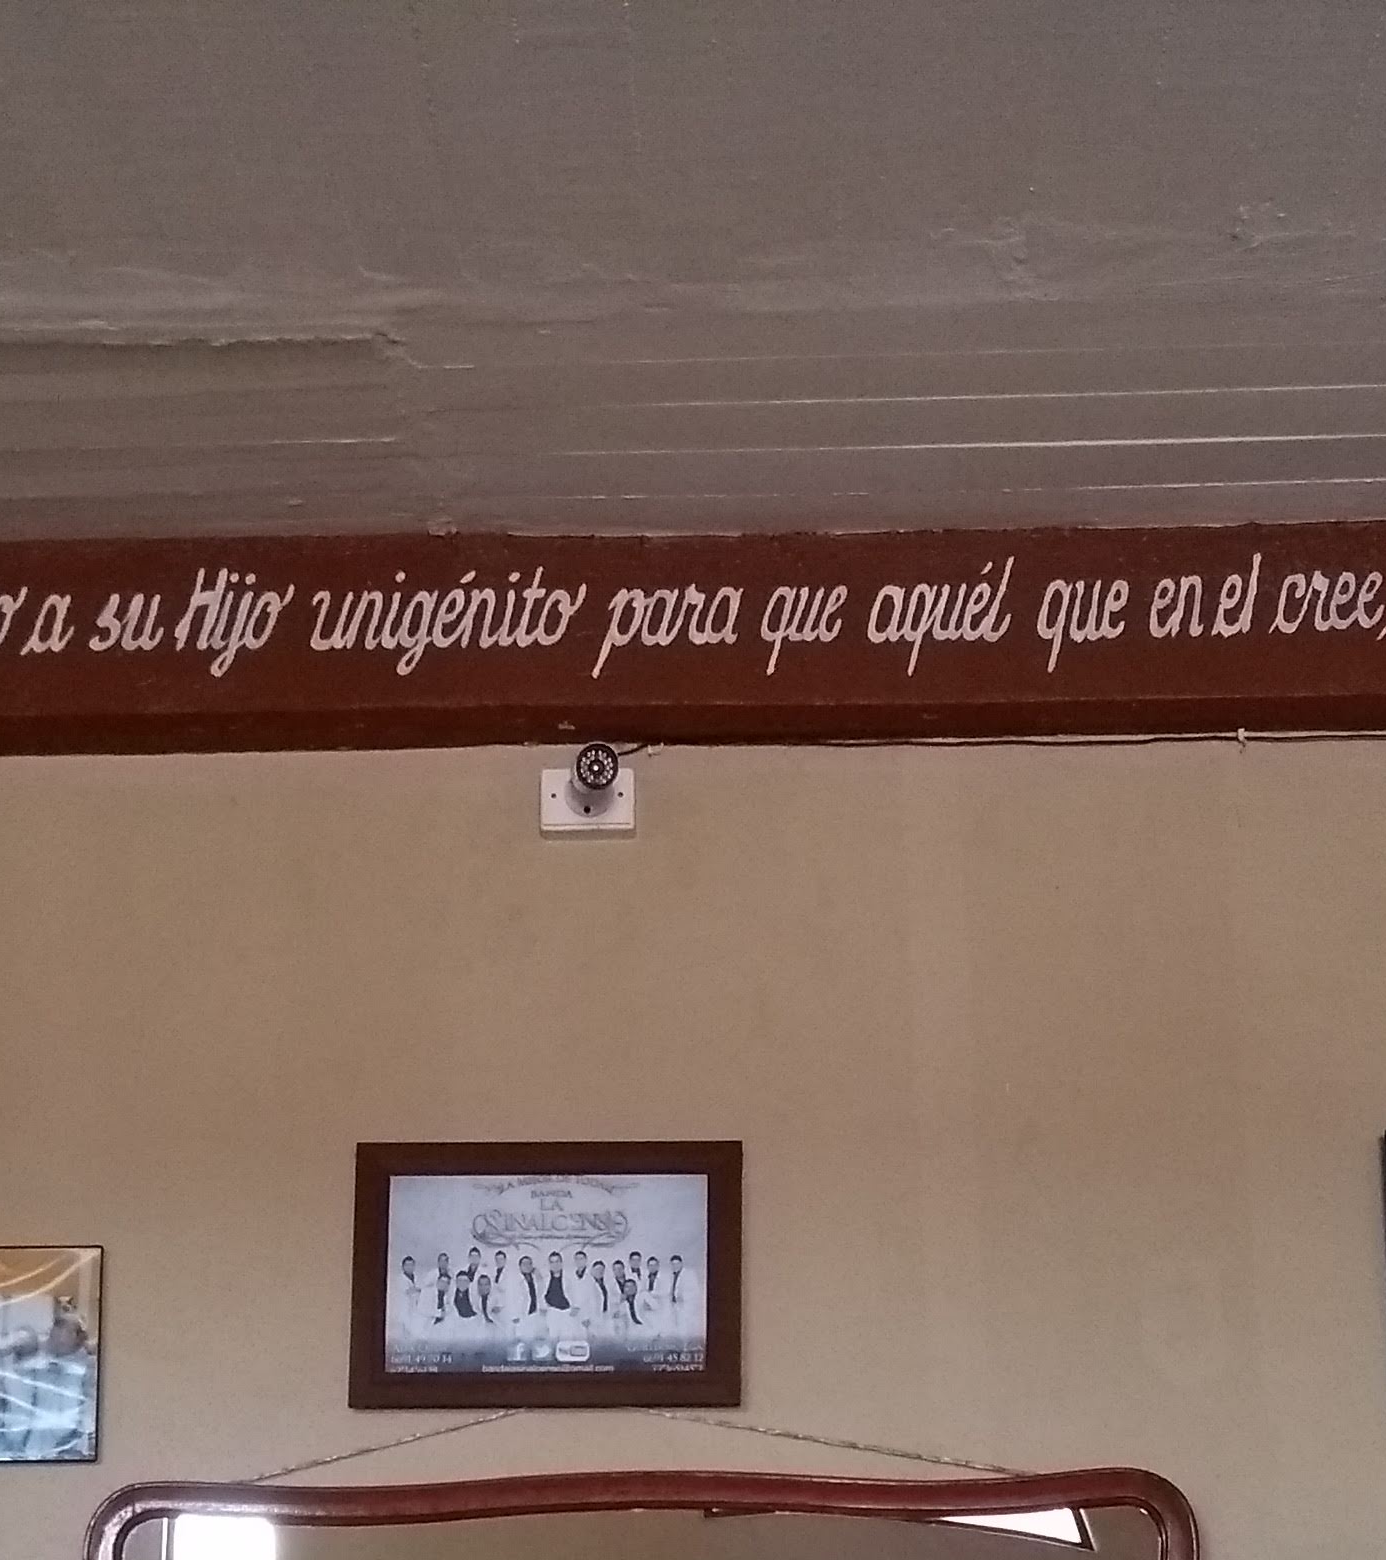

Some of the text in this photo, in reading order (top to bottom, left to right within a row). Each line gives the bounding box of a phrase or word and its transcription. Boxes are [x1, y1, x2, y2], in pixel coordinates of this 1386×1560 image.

[20, 593, 75, 656] a
[89, 592, 165, 652] su
[174, 567, 296, 678] Hijo
[310, 565, 587, 676] unigénito
[592, 582, 745, 680] para
[760, 584, 848, 676] que
[867, 555, 1015, 677] aquél
[1036, 578, 1130, 674] que
[1149, 574, 1205, 639] en
[1210, 552, 1263, 639] el
